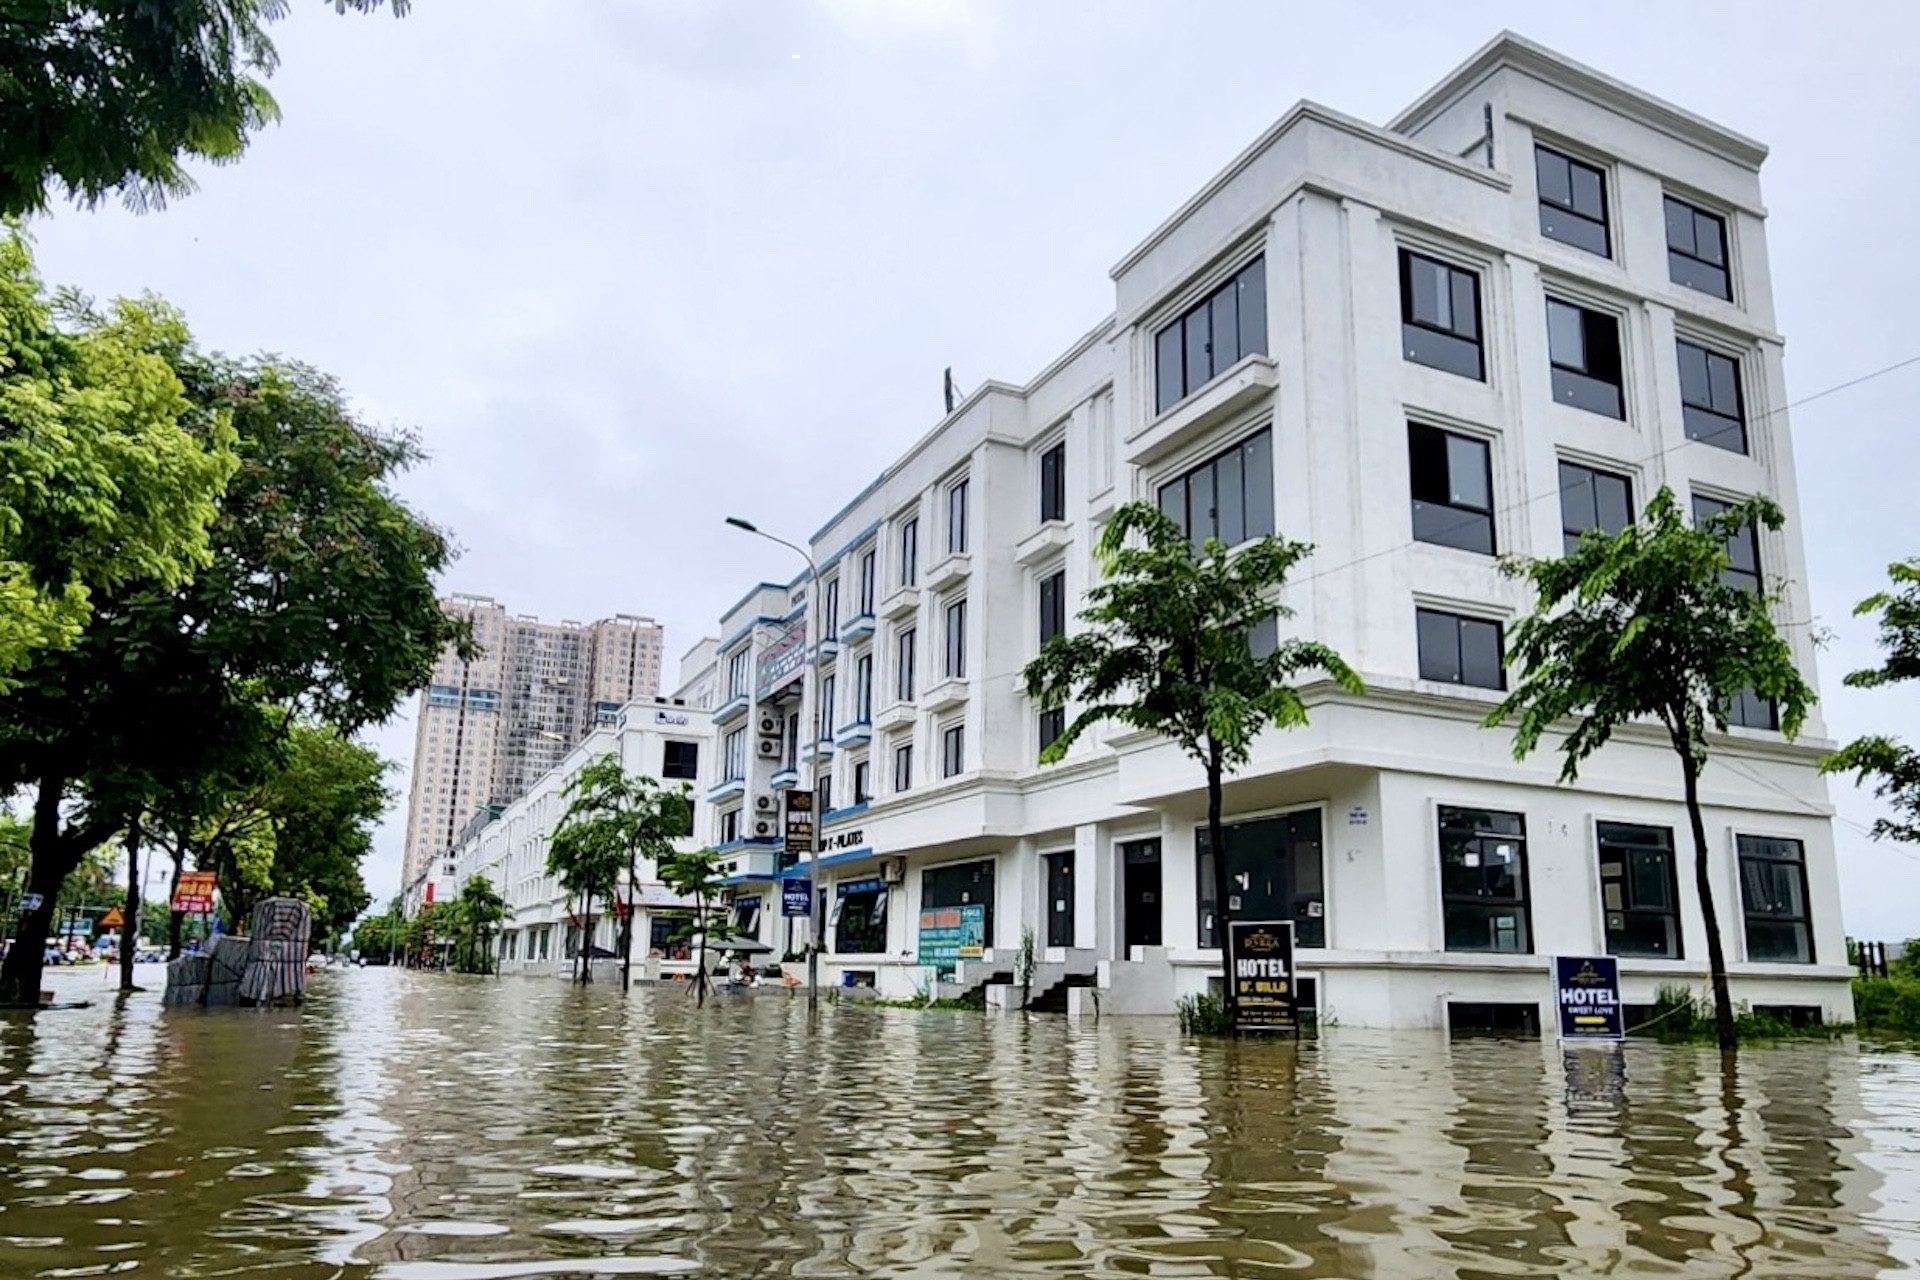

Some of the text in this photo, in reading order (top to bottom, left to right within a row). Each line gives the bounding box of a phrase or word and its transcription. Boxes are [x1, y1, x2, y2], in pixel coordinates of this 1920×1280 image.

[787, 811, 813, 823] HOTE
[784, 892, 809, 902] HOTEL
[1237, 958, 1289, 978] HOTEL
[1560, 988, 1618, 1005] HOTEL
[1568, 1006, 1593, 1015] SWEET
